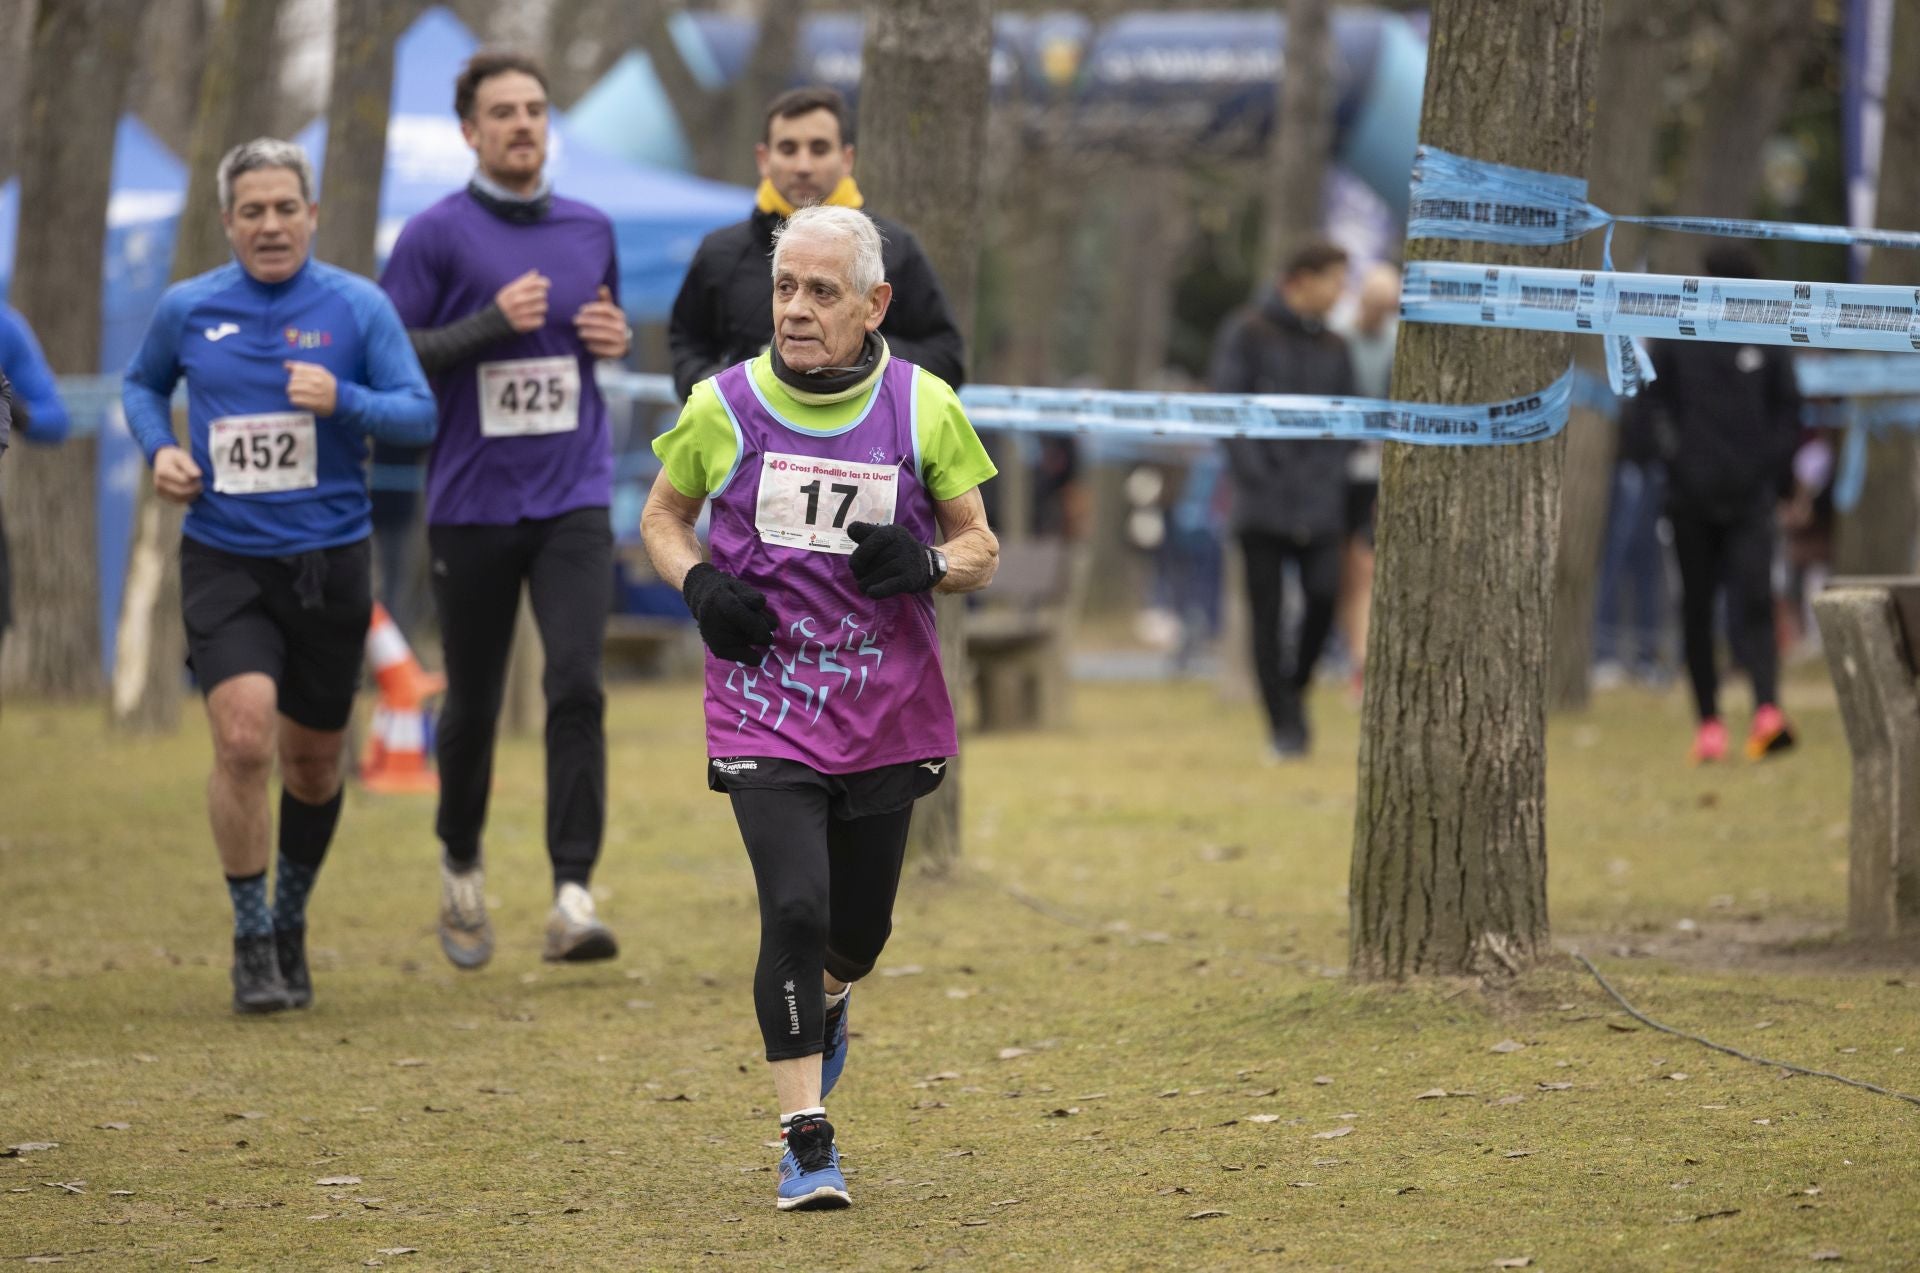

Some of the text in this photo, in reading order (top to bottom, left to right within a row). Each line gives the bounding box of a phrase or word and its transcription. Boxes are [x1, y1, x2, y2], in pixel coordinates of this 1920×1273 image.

[1683, 278, 1699, 293] FMD
[1794, 284, 1811, 300] FMD
[500, 377, 565, 414] 425
[1489, 396, 1542, 419] FMD
[229, 432, 298, 471] 452
[770, 459, 892, 481] 40 Cross Rondilla las 12 Uvas
[800, 479, 859, 529] 17
[785, 995, 801, 1035] luanvi
